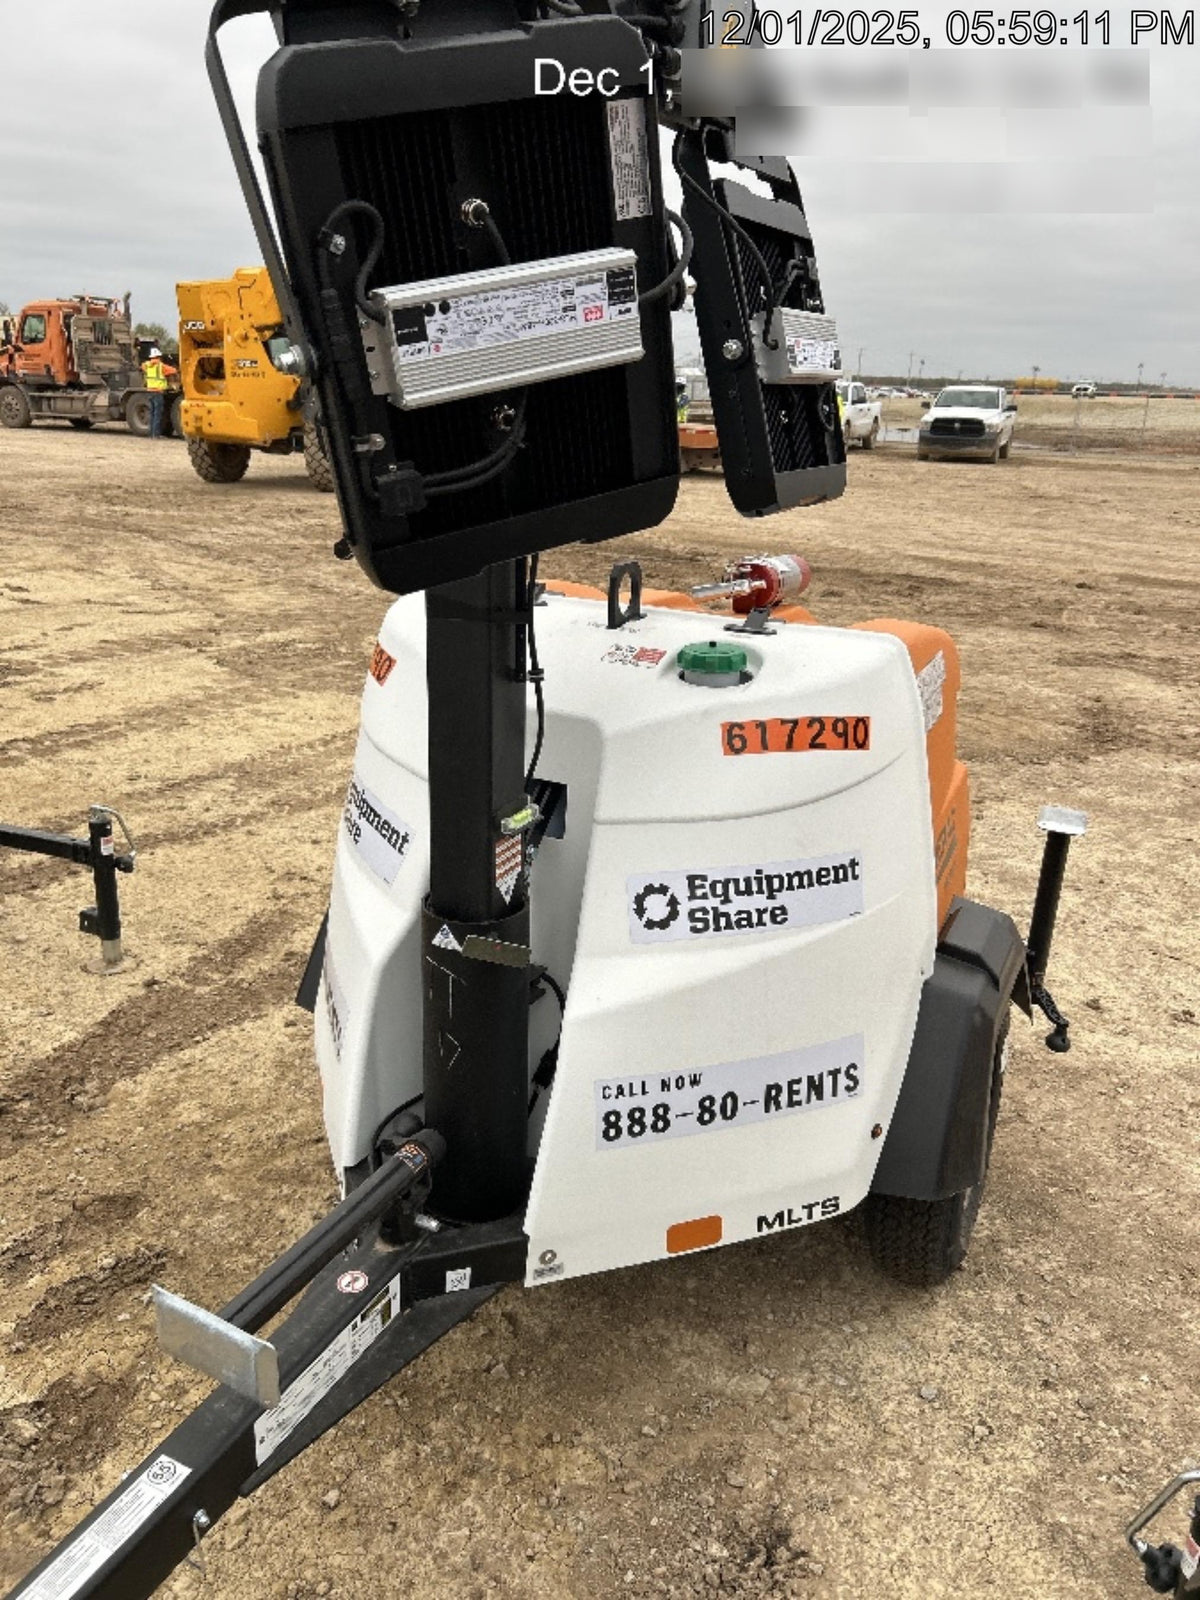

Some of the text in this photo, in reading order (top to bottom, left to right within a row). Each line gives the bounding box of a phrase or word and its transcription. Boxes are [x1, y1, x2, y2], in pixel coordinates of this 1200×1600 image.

[726, 716, 869, 754] 617290
[686, 857, 860, 905] Equipment
[687, 904, 789, 934] Share
[601, 1072, 703, 1100] CALL NOW
[601, 1062, 860, 1142] 888-80-RENTS
[757, 1195, 840, 1233] MLTS
